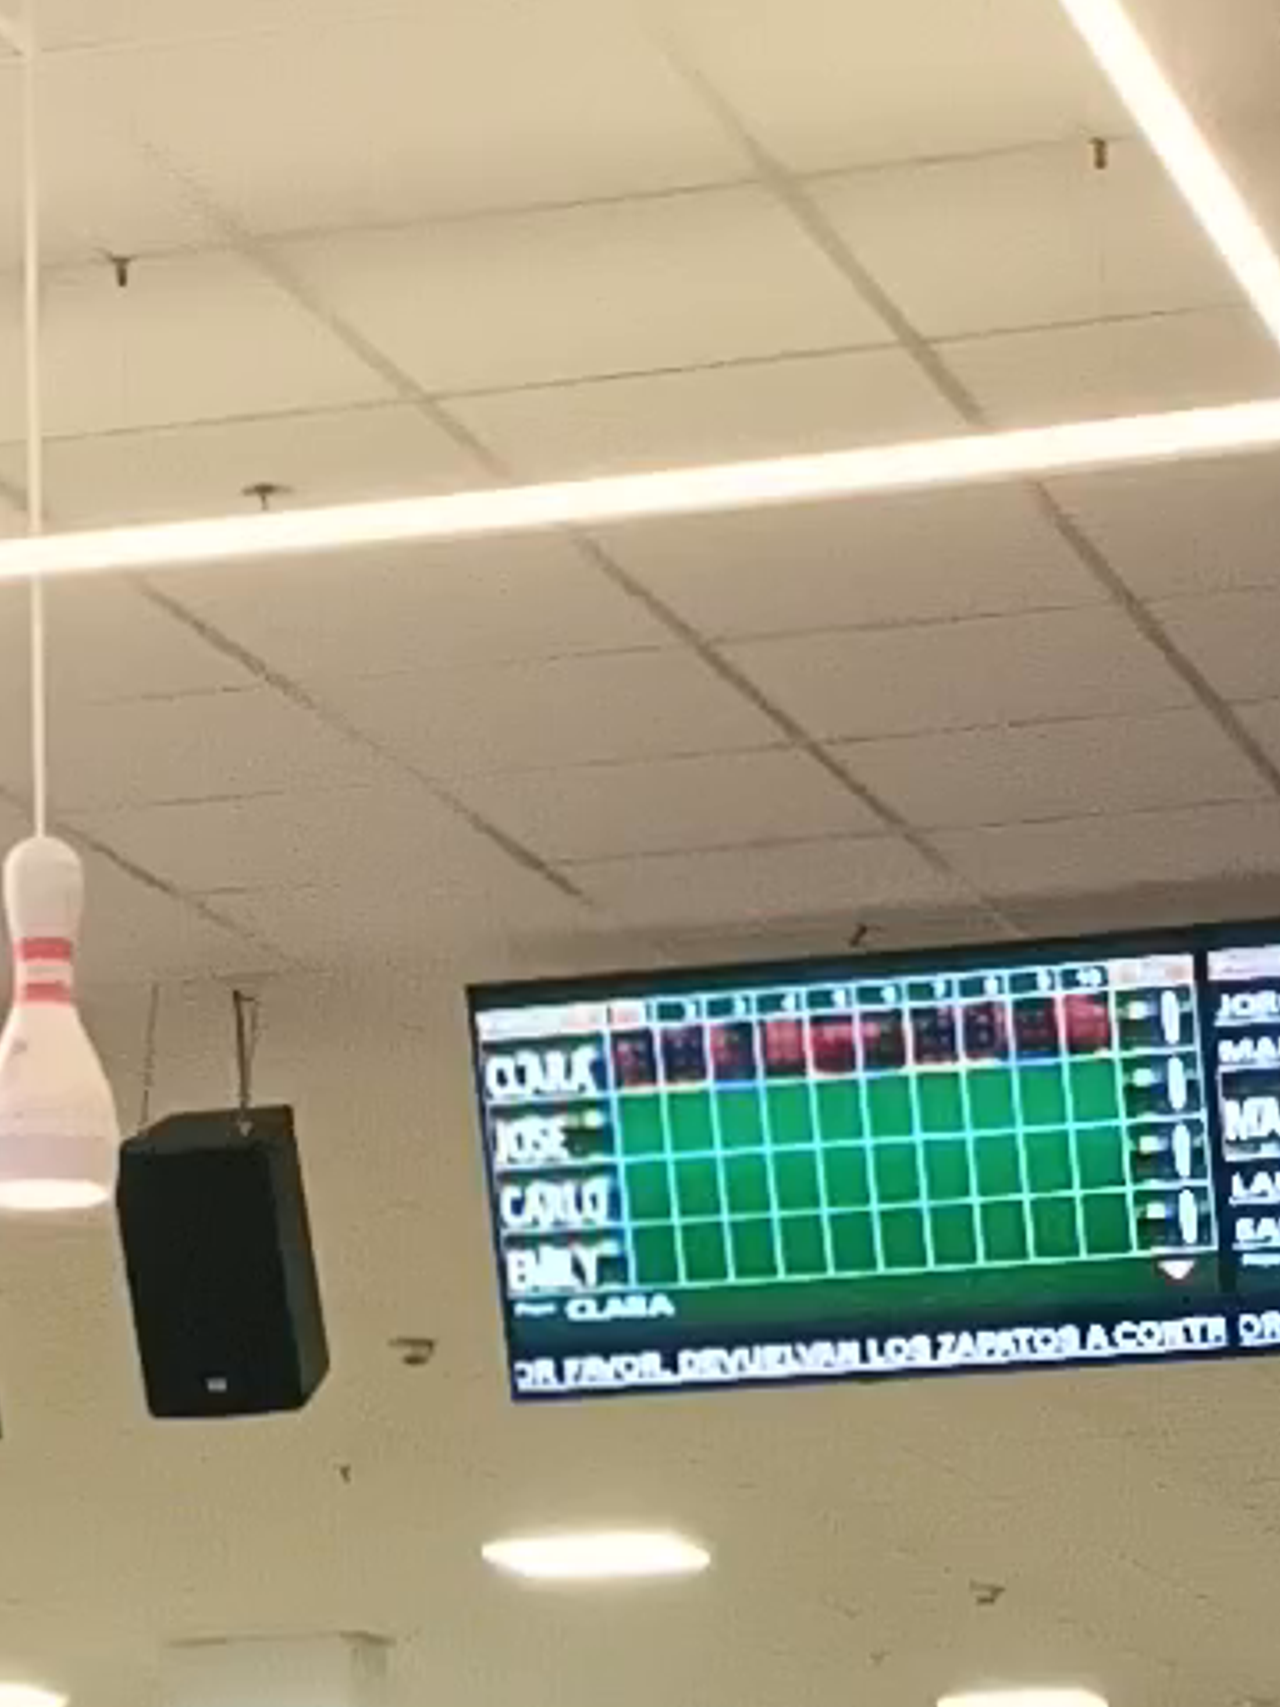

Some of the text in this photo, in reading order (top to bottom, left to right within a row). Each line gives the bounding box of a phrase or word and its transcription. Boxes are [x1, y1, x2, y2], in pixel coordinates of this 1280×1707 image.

[495, 1115, 570, 1164] JOSE
[565, 1294, 675, 1320] CLARA
[866, 1334, 930, 1371] LOS
[937, 1324, 1080, 1367] ZAPATOS
[1086, 1324, 1110, 1357] A
